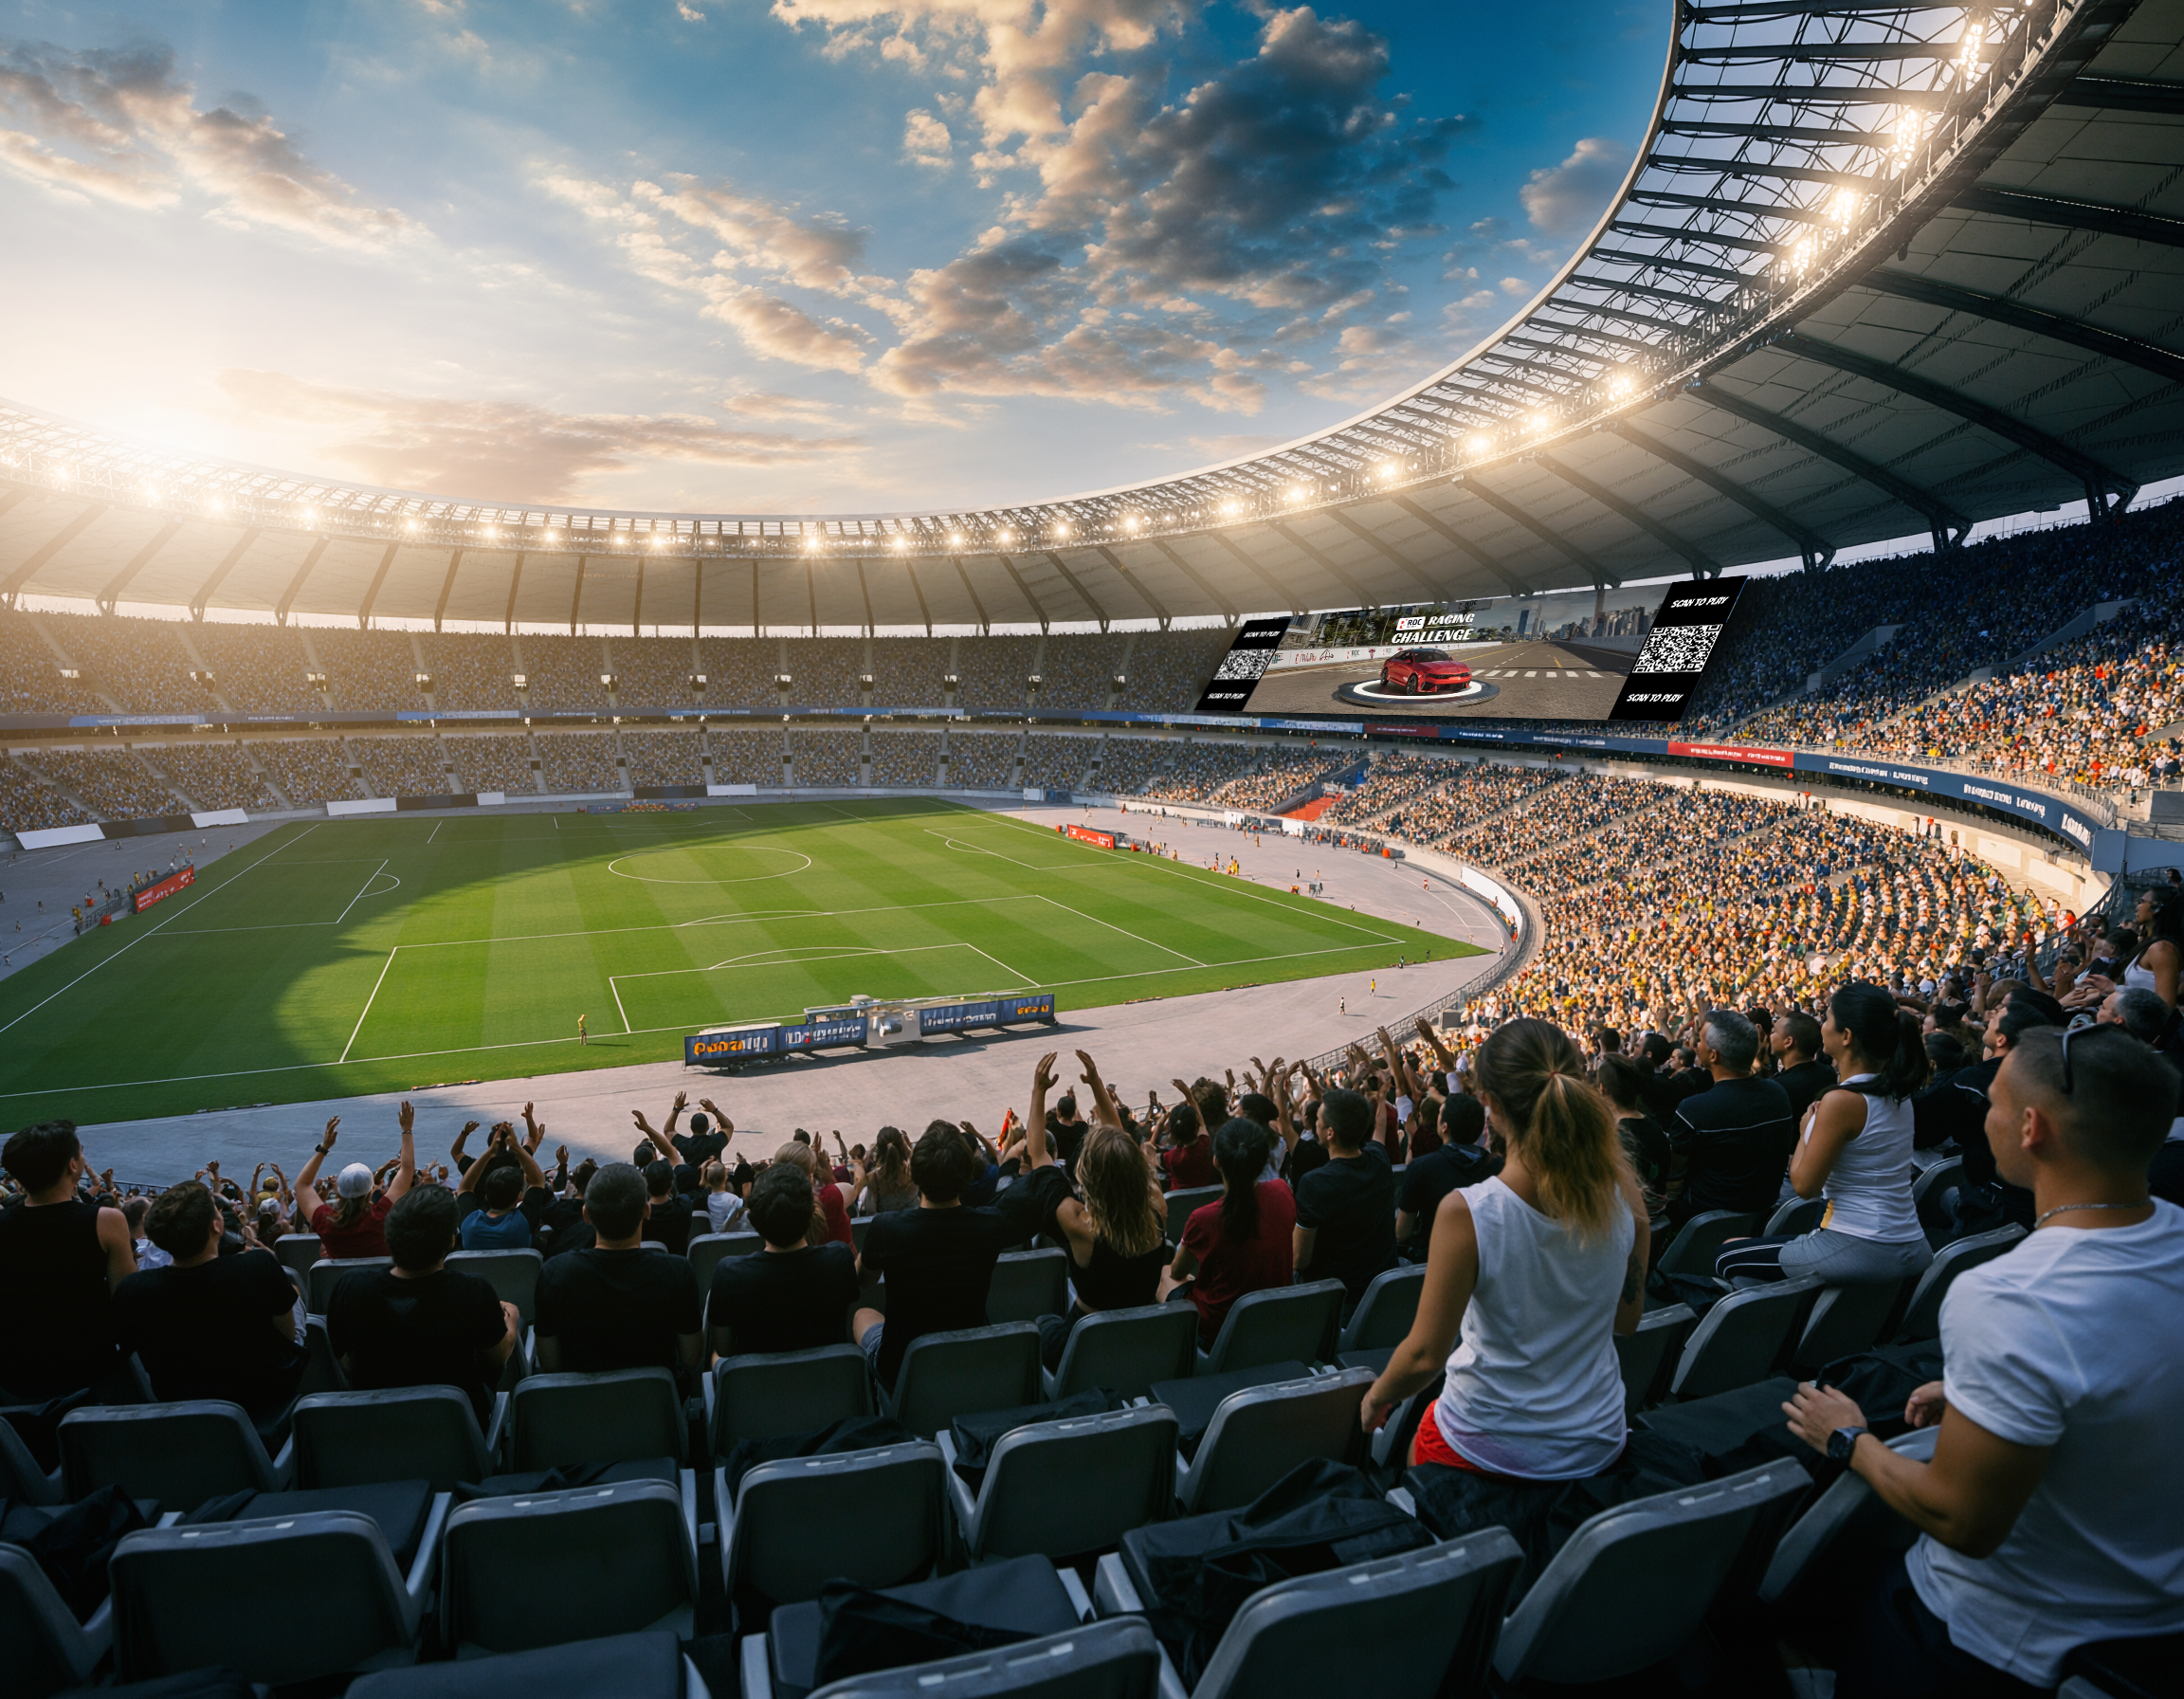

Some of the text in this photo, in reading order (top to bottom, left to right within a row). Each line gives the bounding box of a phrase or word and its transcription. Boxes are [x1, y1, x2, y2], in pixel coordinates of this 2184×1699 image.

[1670, 596, 1730, 608] SCAN TO PLAY
[1428, 612, 1475, 626] RACING
[1392, 628, 1475, 644] CHALLENGE
[1626, 693, 1684, 702] SCAN TO PLAY
